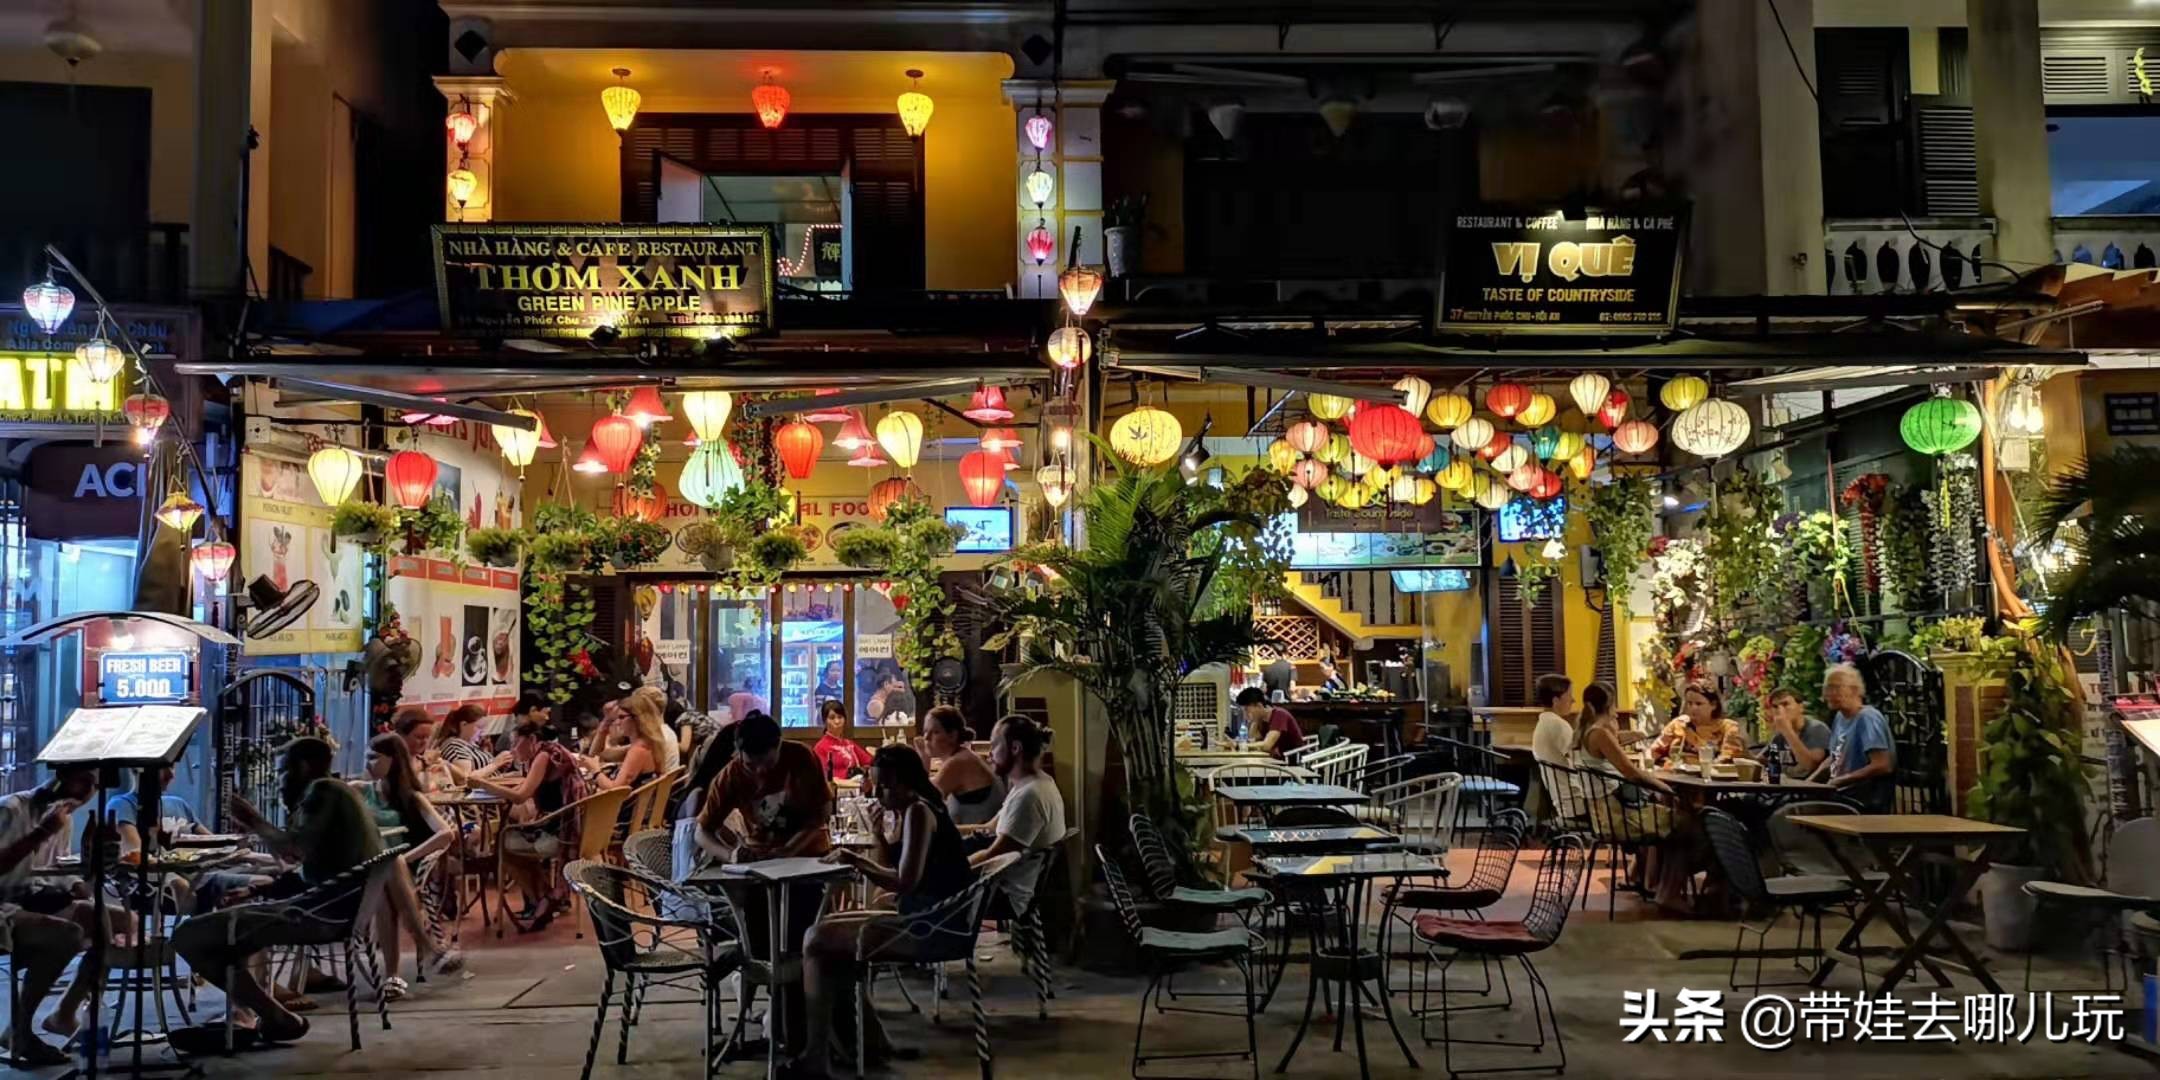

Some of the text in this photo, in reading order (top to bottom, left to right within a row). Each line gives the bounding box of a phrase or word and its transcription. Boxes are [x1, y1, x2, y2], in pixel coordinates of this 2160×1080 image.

[1457, 216, 1512, 229] RESTAURANT
[1525, 216, 1558, 230] COFFEE
[449, 237, 759, 258] NHÀ HÀNG & CAFE RESTAURANT
[1492, 234, 1637, 283] VỊ QUÊ
[470, 262, 742, 291] THƠM XANH
[1482, 288, 1636, 302] TASTE OF COUNTRYSIDE
[518, 296, 702, 312] GREEN PINEAPPLE
[524, 314, 553, 325] Phúc
[556, 315, 579, 325] Chu
[634, 315, 650, 325] An
[107, 658, 181, 673] FRESH BEER
[117, 678, 171, 698] 5.000
